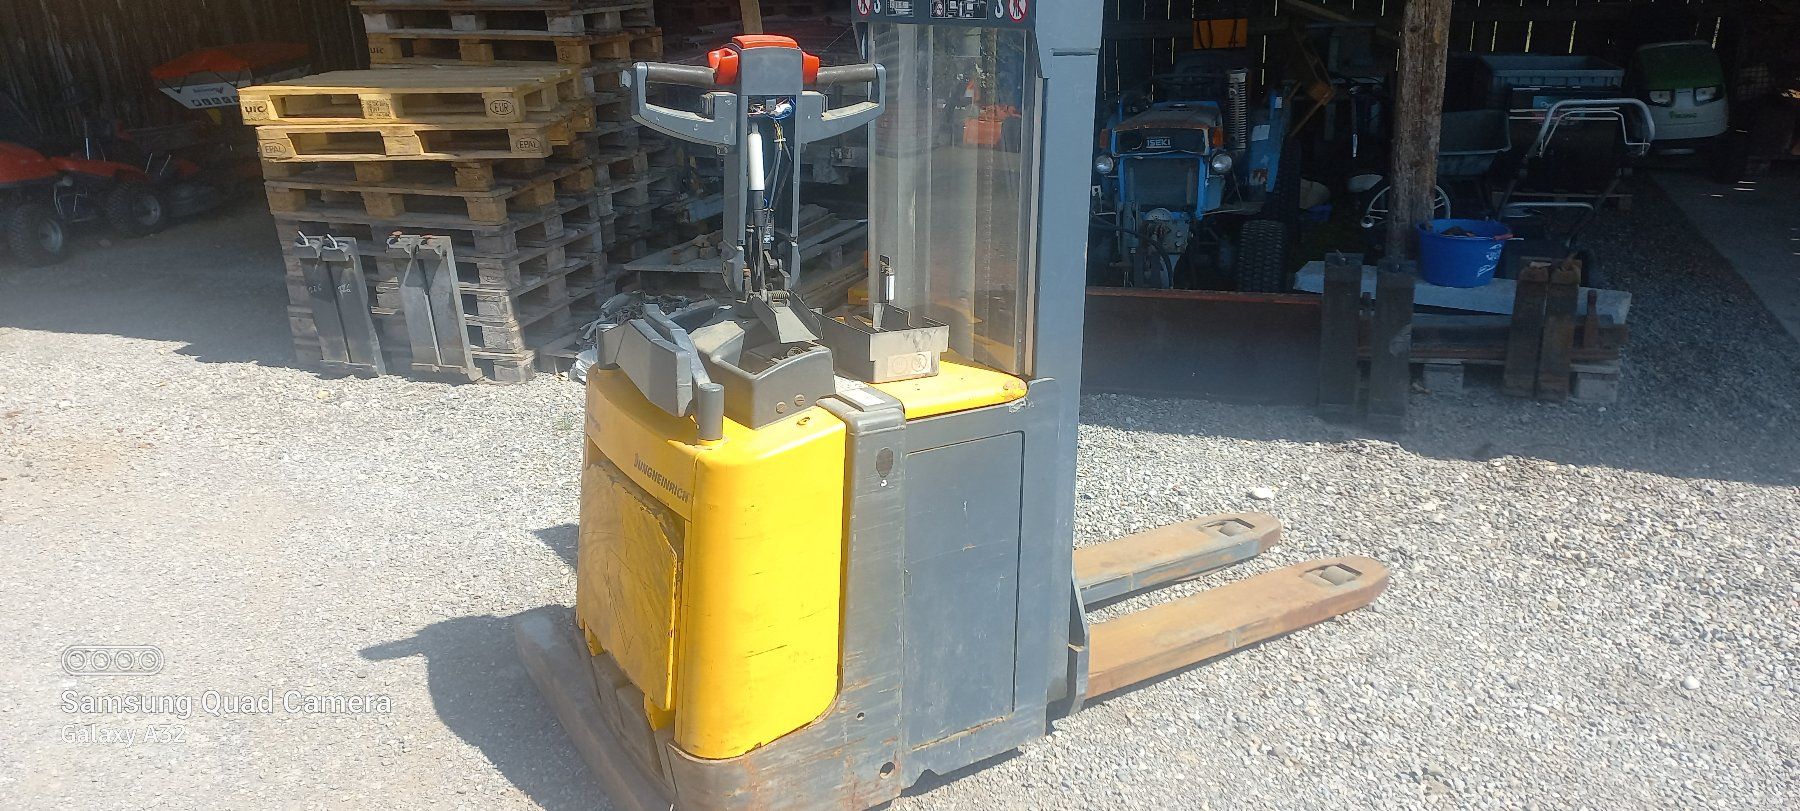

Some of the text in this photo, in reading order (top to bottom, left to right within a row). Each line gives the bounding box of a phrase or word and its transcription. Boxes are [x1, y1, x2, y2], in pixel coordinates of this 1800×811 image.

[494, 102, 509, 113] EUR
[519, 140, 537, 149] EPAL
[1146, 138, 1171, 146] ISEKI
[264, 144, 284, 153] EPAL
[633, 452, 690, 504] JUNGHEINRICH
